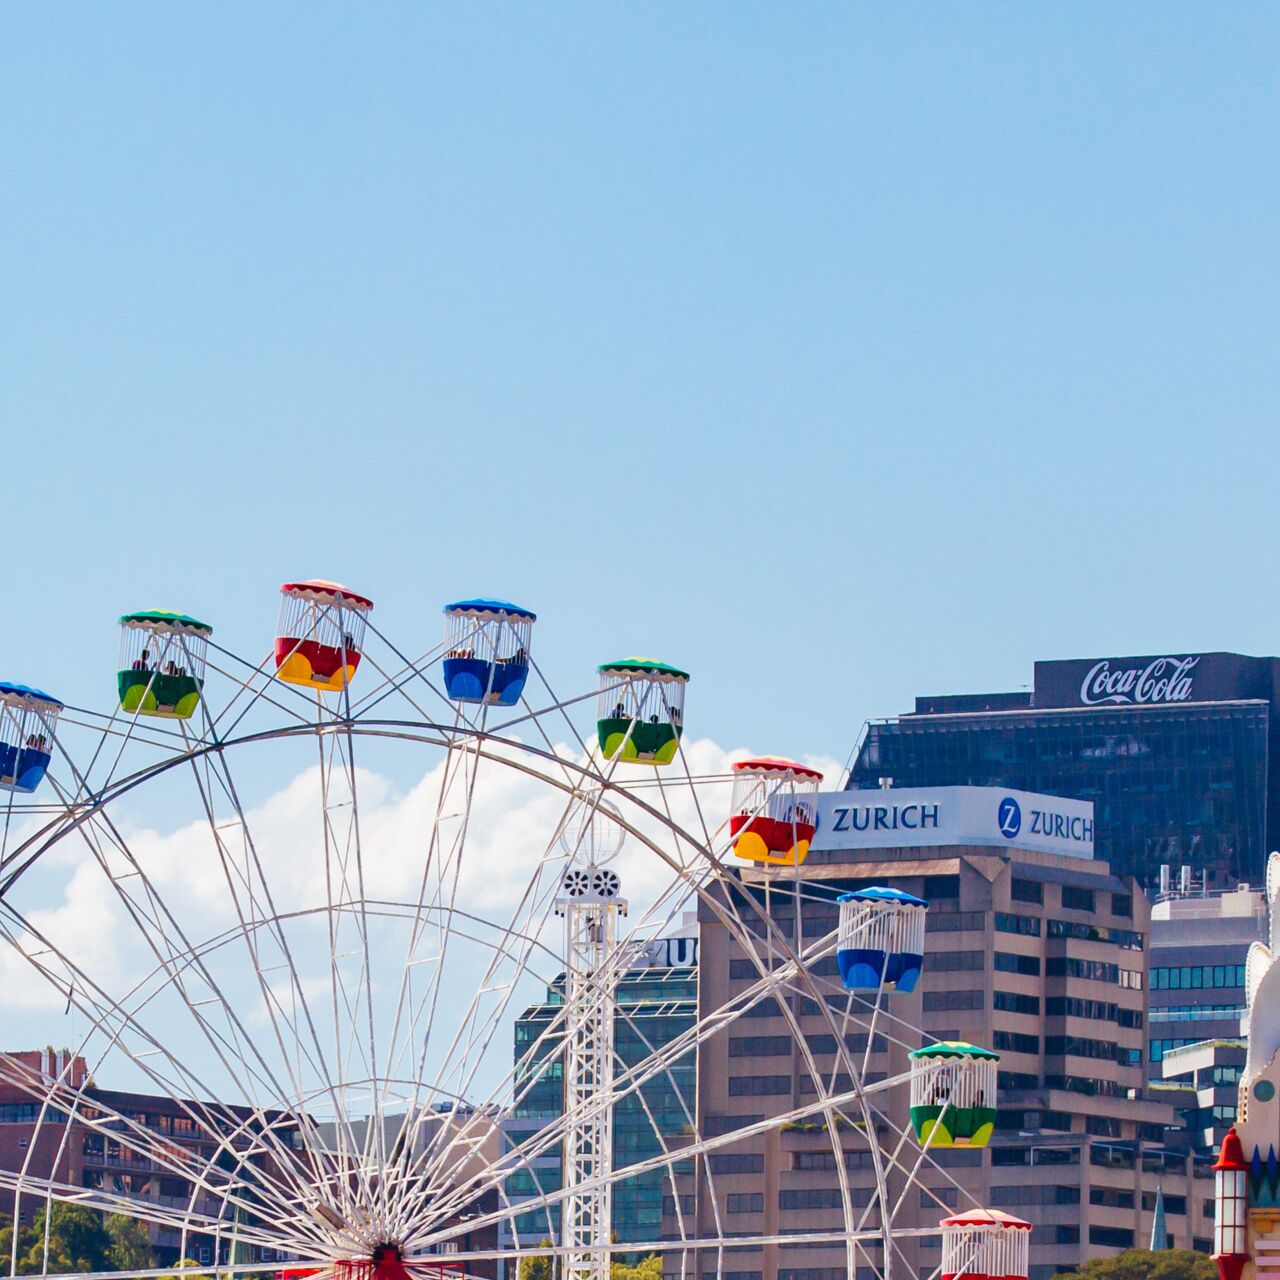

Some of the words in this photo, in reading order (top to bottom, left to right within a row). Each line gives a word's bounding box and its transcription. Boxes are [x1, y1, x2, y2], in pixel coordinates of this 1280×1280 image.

[1081, 656, 1200, 704] Coca-Cola
[832, 804, 939, 832] ZURICH
[1030, 810, 1094, 842] ZURICH
